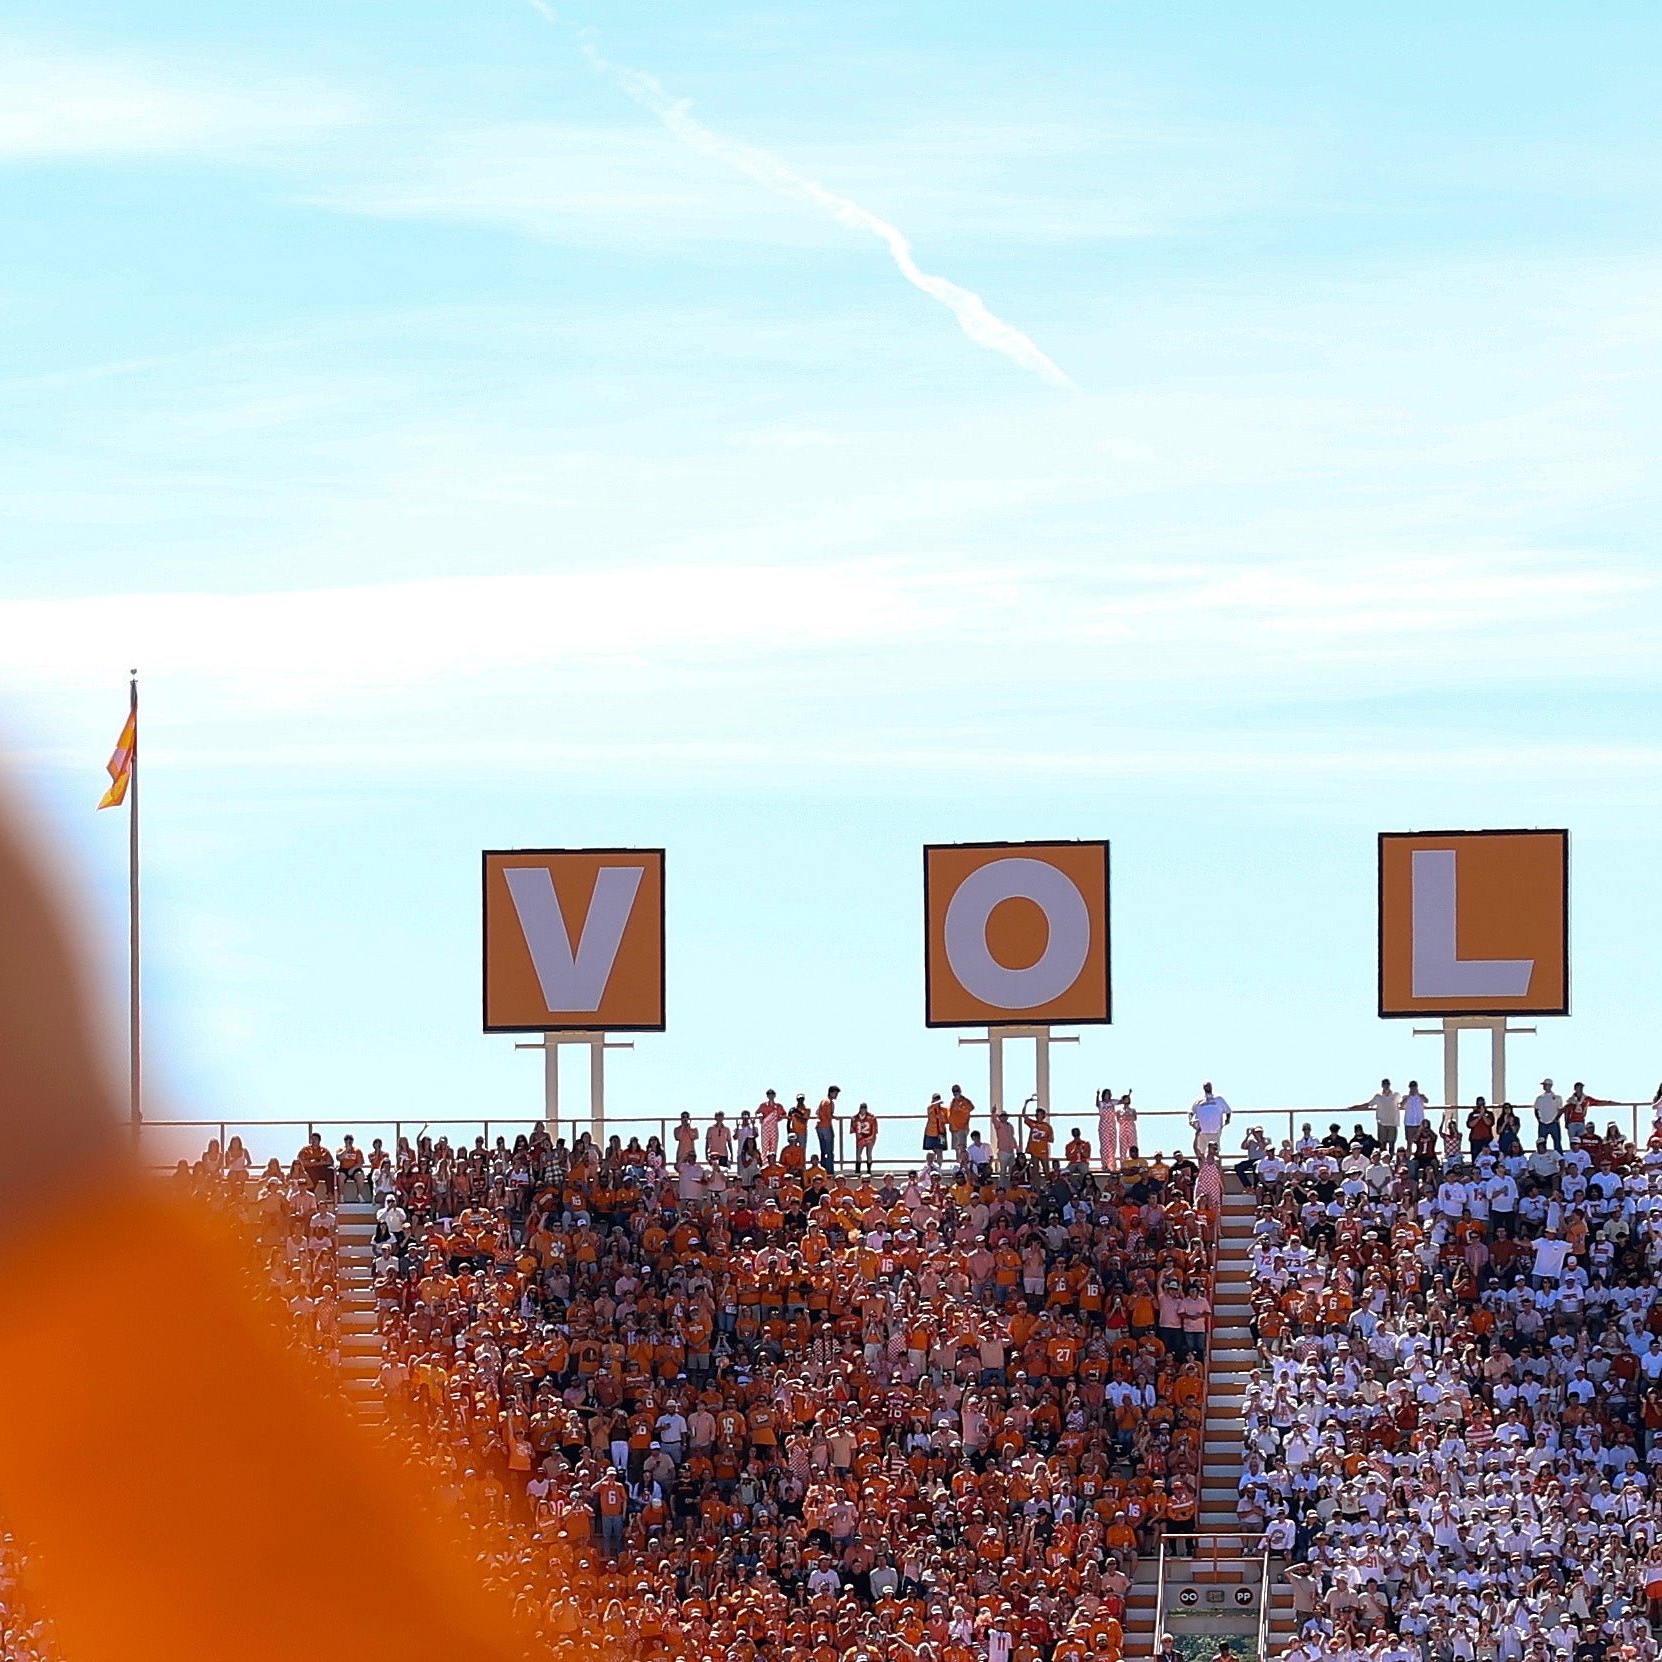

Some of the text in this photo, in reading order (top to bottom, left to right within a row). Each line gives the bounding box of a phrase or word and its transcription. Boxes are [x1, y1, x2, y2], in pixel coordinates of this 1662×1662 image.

[502, 849, 1535, 1013] V O L
[1057, 1349, 1070, 1361] 27
[608, 1491, 616, 1503] 6
[1180, 1592, 1197, 1601] OO
[1237, 1592, 1251, 1601] PP
